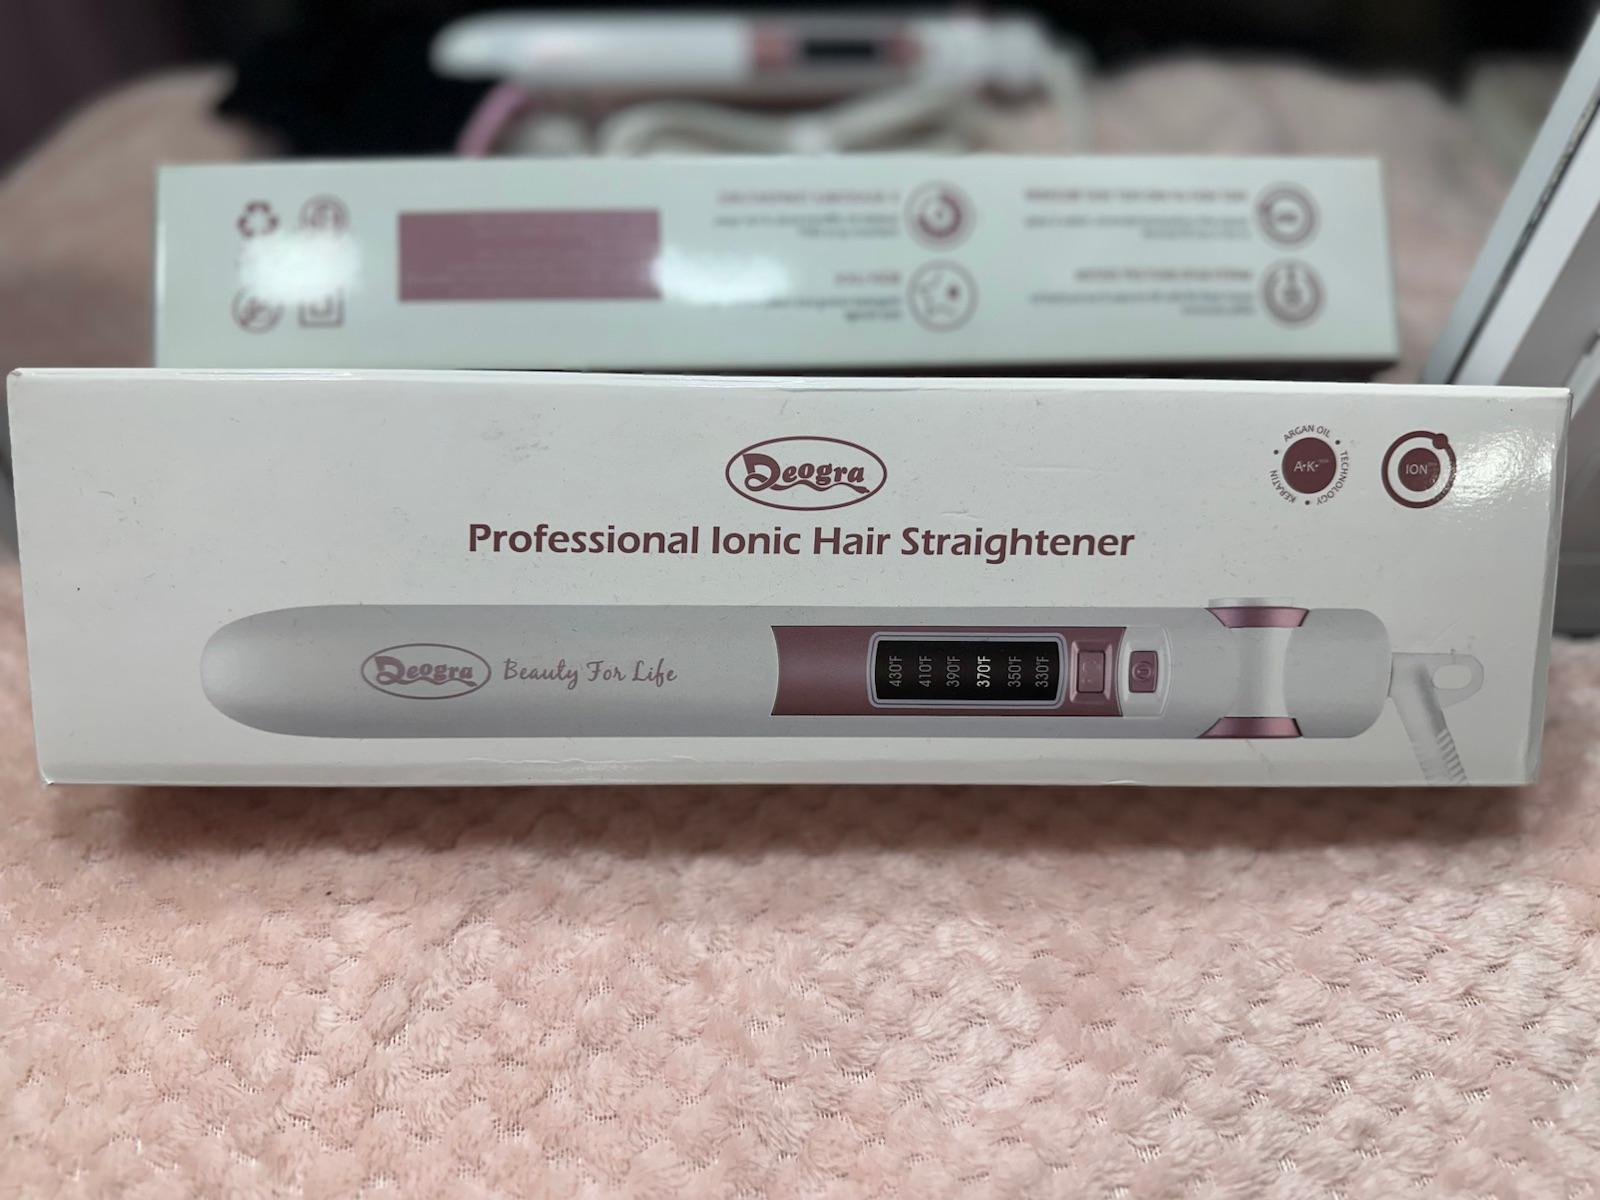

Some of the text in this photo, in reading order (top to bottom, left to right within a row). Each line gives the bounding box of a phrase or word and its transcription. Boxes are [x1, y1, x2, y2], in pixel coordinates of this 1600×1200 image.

[1283, 424, 1331, 442] ARGAN OIL
[742, 453, 871, 494] Deogra
[1269, 469, 1297, 503] KERATIN
[1316, 450, 1349, 505] TECHNOLOGY
[1405, 463, 1428, 475] ION
[469, 523, 1135, 565] Professional Ionic Hair Straightener
[374, 656, 678, 690] Deogra Beauty For Life
